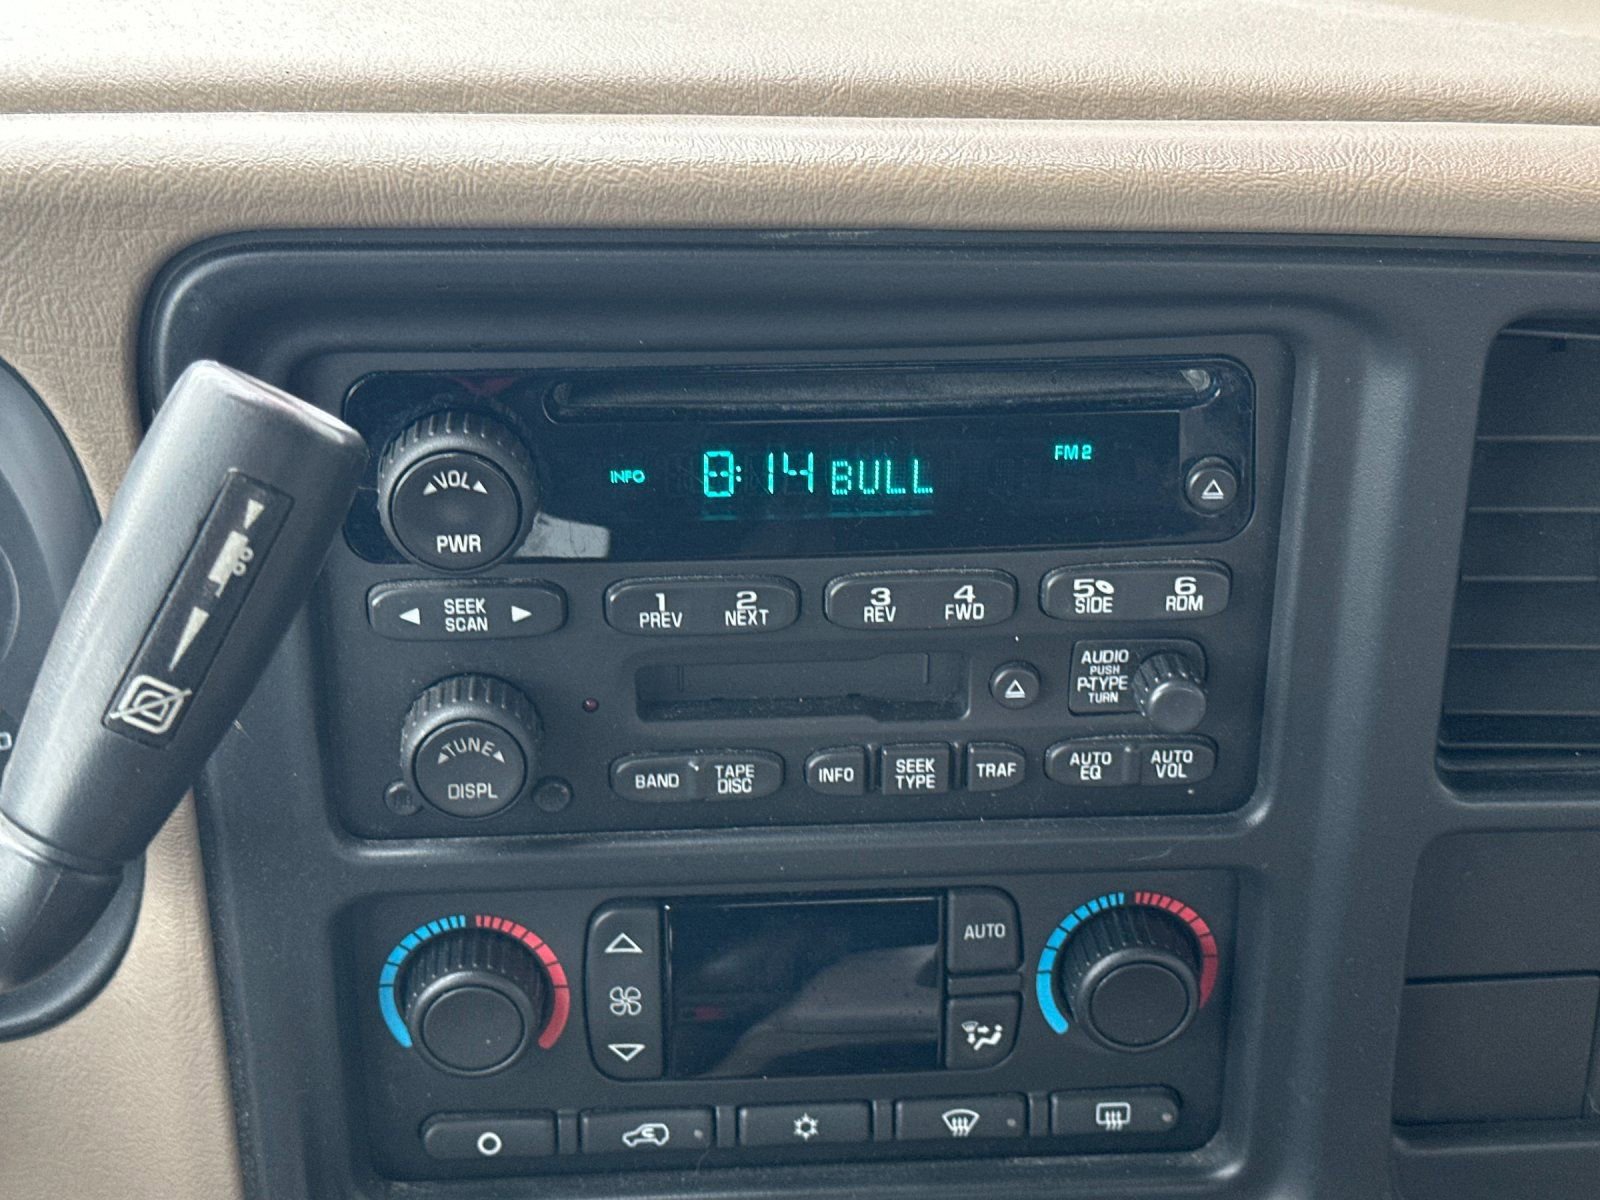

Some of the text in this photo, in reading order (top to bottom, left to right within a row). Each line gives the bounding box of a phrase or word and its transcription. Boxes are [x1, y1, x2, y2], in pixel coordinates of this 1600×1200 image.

[436, 470, 469, 490] VOL
[611, 470, 645, 483] INFO
[704, 451, 933, 497] 8:14 BULL
[437, 535, 481, 552] PWR
[954, 585, 975, 602] 4
[1074, 579, 1094, 595] 5
[1175, 577, 1196, 595] 6
[656, 593, 665, 611] 1
[737, 591, 757, 609] 2
[871, 588, 890, 606] 3
[1075, 597, 1112, 613] SIDE
[1166, 595, 1203, 611] RDM
[444, 598, 486, 614] SEEK
[864, 606, 896, 622] REV
[945, 603, 984, 620] FWD
[446, 617, 488, 632] SCAN
[640, 611, 682, 628] PREV
[725, 609, 768, 626] NEXT
[1082, 650, 1128, 664] AUDIO
[1090, 665, 1120, 675] PUSH
[1078, 676, 1127, 691] P-TYPE
[1089, 692, 1118, 703] TURN
[447, 737, 495, 757] TUNE
[1070, 752, 1111, 768] AUTO
[1151, 750, 1193, 764] AUTO
[715, 765, 754, 778] TAPE
[819, 768, 854, 782] INFO
[896, 759, 934, 775] SEEK
[977, 763, 1016, 777] TRAF
[1081, 766, 1101, 780] EQ
[1154, 763, 1187, 778] VOL
[636, 774, 679, 788] BAND
[718, 778, 751, 793] DISC
[896, 775, 935, 789] TYPE
[448, 783, 497, 799] DISPL
[965, 924, 1005, 939] AUTO
